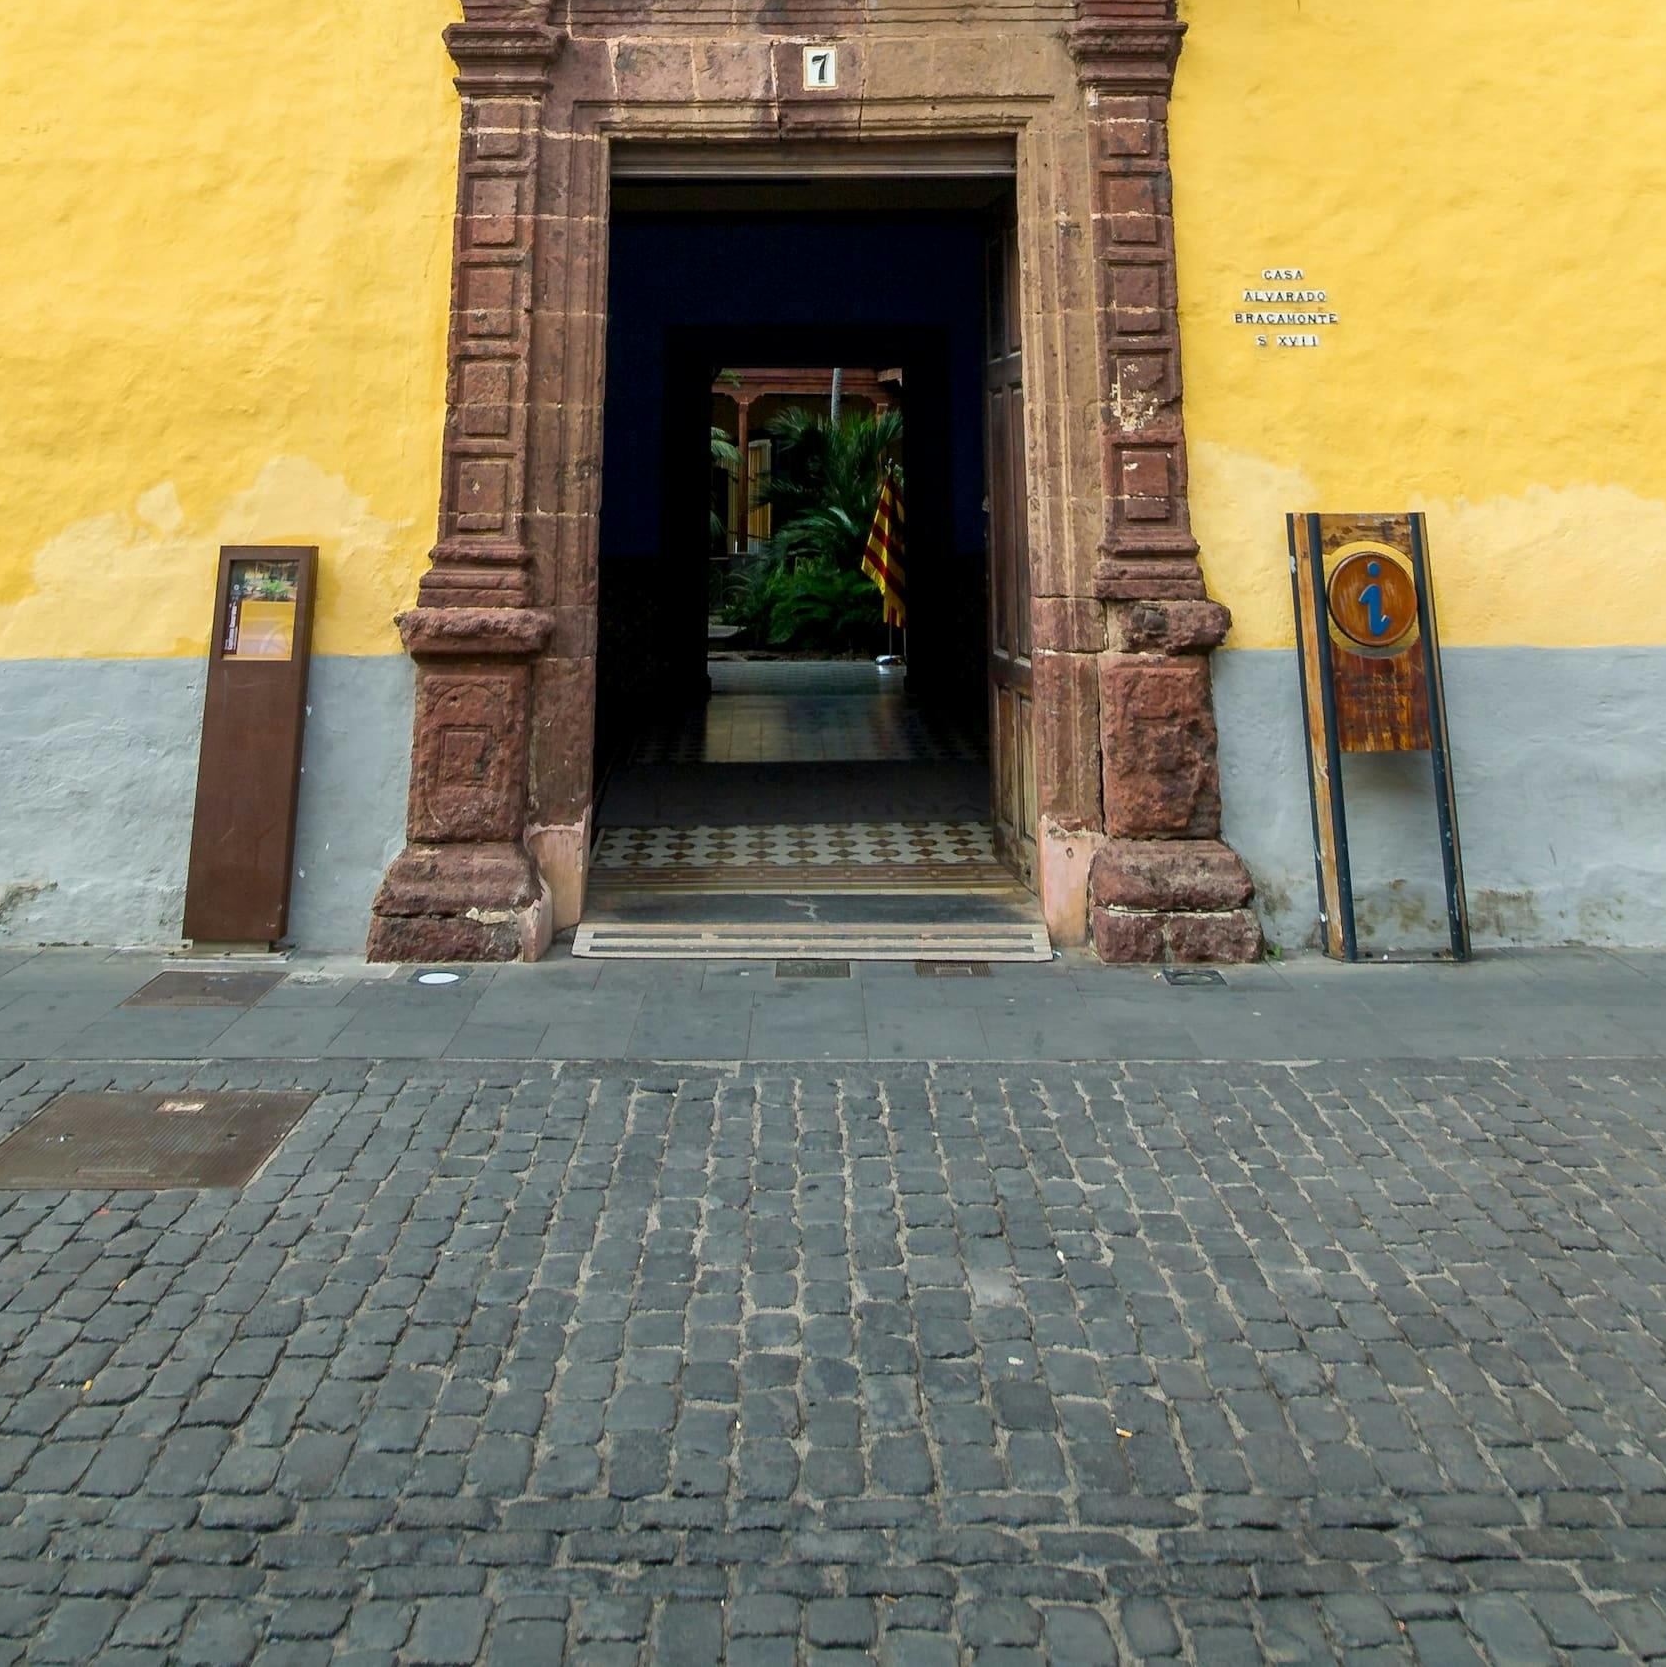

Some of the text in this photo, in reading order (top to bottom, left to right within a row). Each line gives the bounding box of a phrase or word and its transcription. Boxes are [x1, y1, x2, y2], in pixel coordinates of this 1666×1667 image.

[811, 53, 830, 83] 7
[1263, 270, 1304, 281] CASA
[1244, 291, 1326, 302] ALVARADO
[1235, 313, 1338, 325] BRACAMONTE
[1257, 336, 1318, 346] S XVII
[1358, 561, 1391, 637] i
